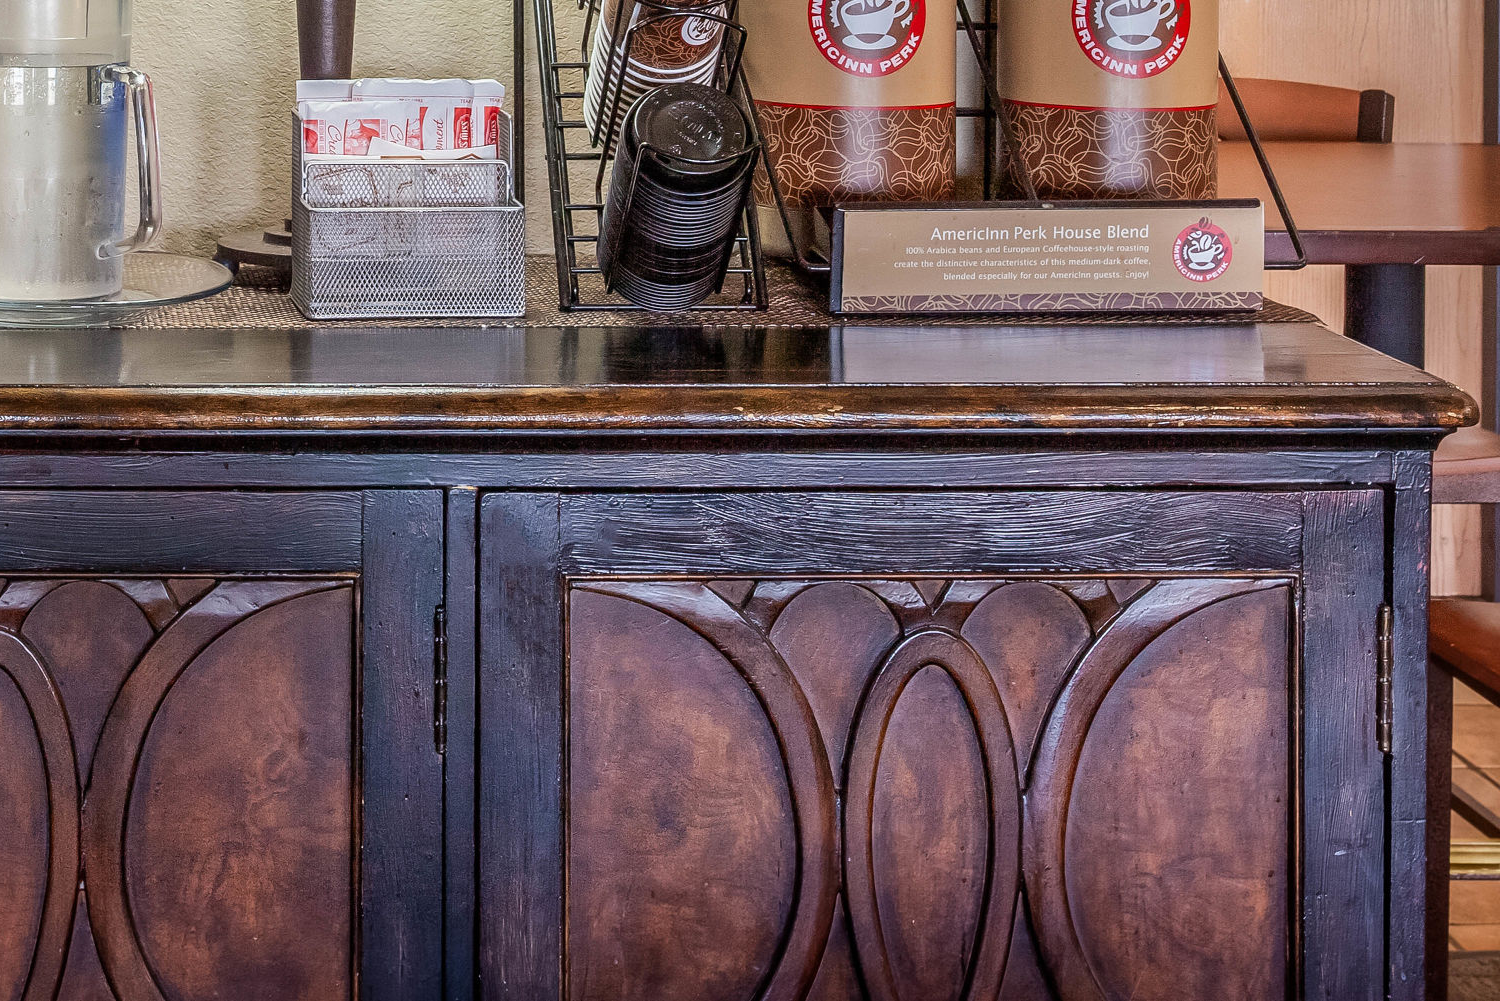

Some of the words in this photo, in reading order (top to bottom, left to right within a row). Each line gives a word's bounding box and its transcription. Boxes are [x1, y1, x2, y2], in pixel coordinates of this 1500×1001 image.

[880, 32, 921, 73] PERK
[1144, 33, 1186, 75] PERK
[930, 227, 1009, 241] AmericInn
[1014, 226, 1047, 240] Perk
[1053, 226, 1101, 239] House
[1107, 224, 1149, 239] Blend
[906, 246, 925, 255] 100%
[926, 246, 957, 254] Arabica
[959, 246, 982, 254] beans
[985, 245, 1000, 253] and
[1003, 245, 1040, 255] European
[1117, 244, 1150, 254] roasting
[894, 260, 918, 268] create
[921, 259, 934, 267] the
[936, 259, 978, 267] distinctive
[980, 259, 1037, 267] characteristics
[1040, 258, 1049, 266] of
[1051, 258, 1066, 266] this
[1068, 257, 1121, 266] medium-dark
[1173, 238, 1204, 281] AMERICINN
[1206, 261, 1229, 281] PERK
[943, 272, 976, 281] blended
[978, 271, 1017, 282] especially
[1020, 271, 1031, 279] for
